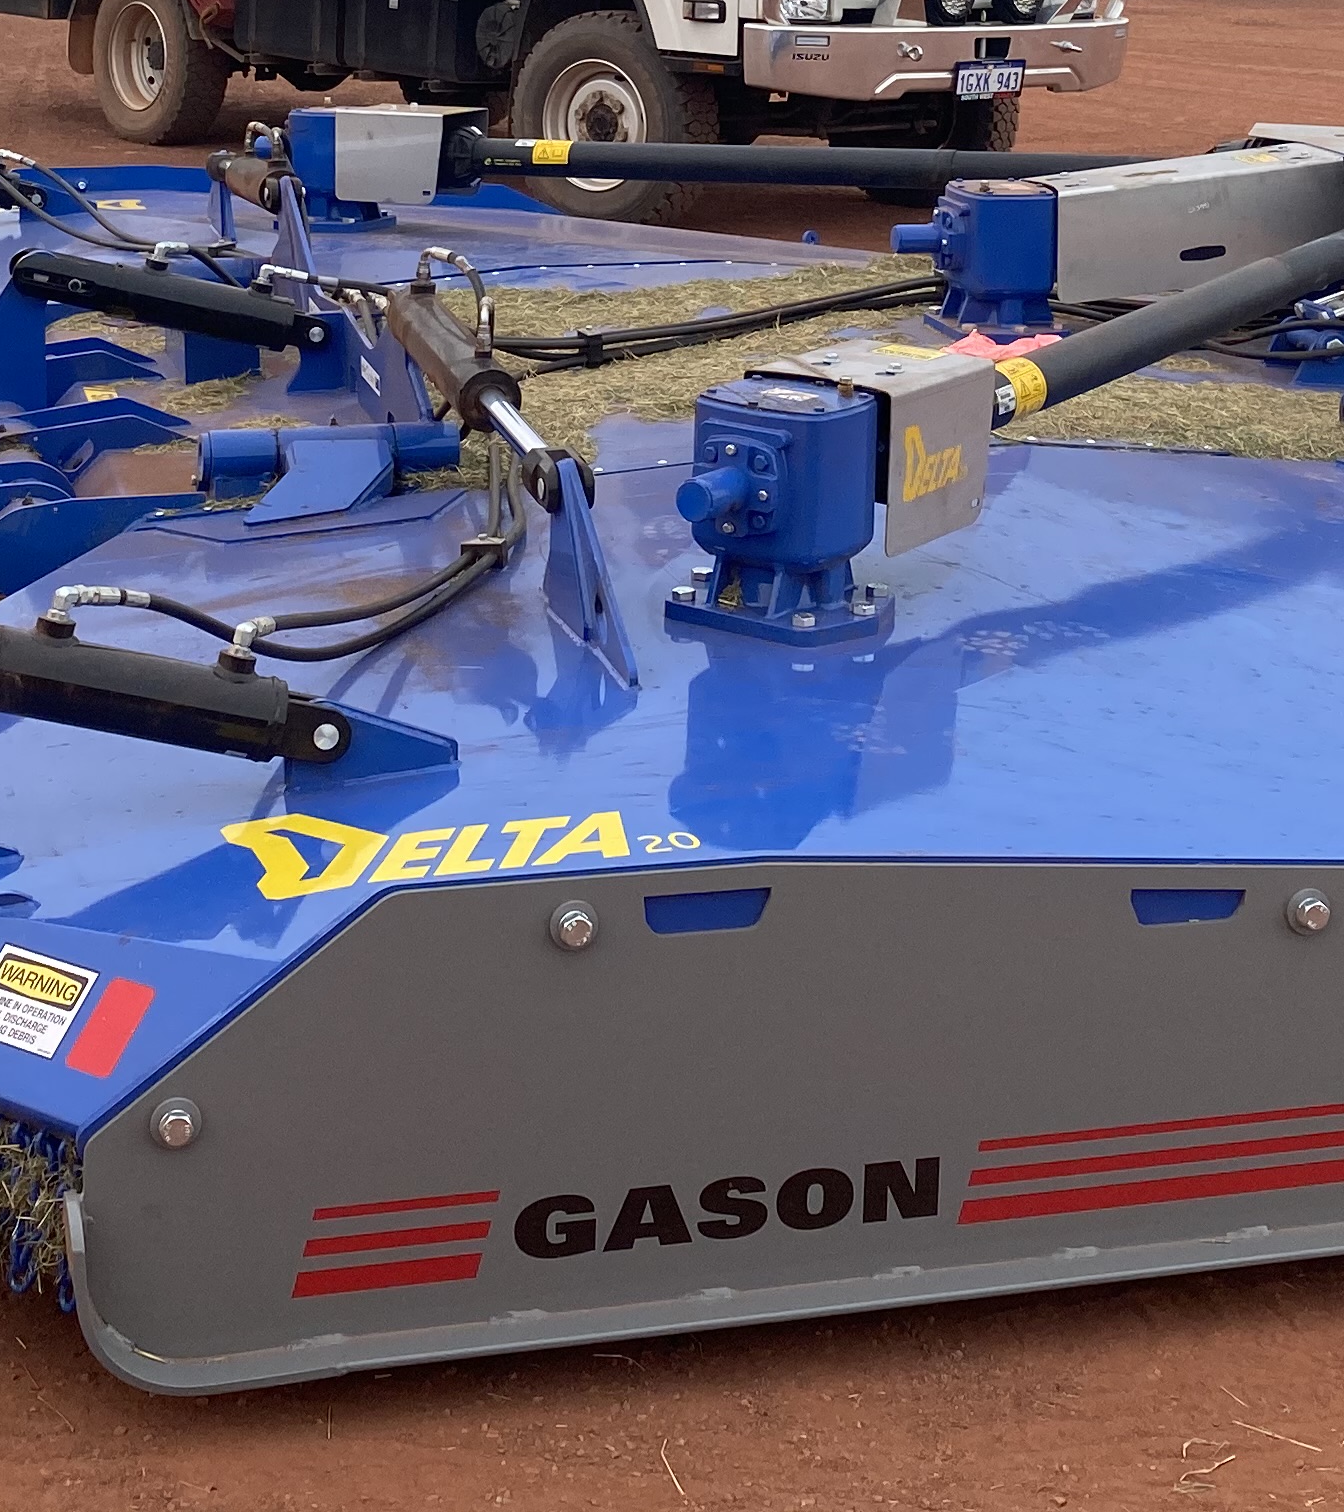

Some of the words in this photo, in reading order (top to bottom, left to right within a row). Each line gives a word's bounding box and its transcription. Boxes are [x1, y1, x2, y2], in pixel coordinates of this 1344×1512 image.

[792, 53, 830, 61] ISUZU
[960, 72, 992, 93] 1GXK
[997, 71, 1019, 91] 943
[902, 424, 962, 503] DELTA
[220, 811, 632, 900] DELTA
[636, 830, 702, 854] 20
[0, 962, 79, 1003] WARNING
[2, 1010, 49, 1035] DISCHARGE
[12, 999, 22, 1010] IN
[21, 1004, 68, 1026] OPERATION
[7, 1027, 38, 1045] DEBRIS
[513, 1156, 941, 1260] GASON
